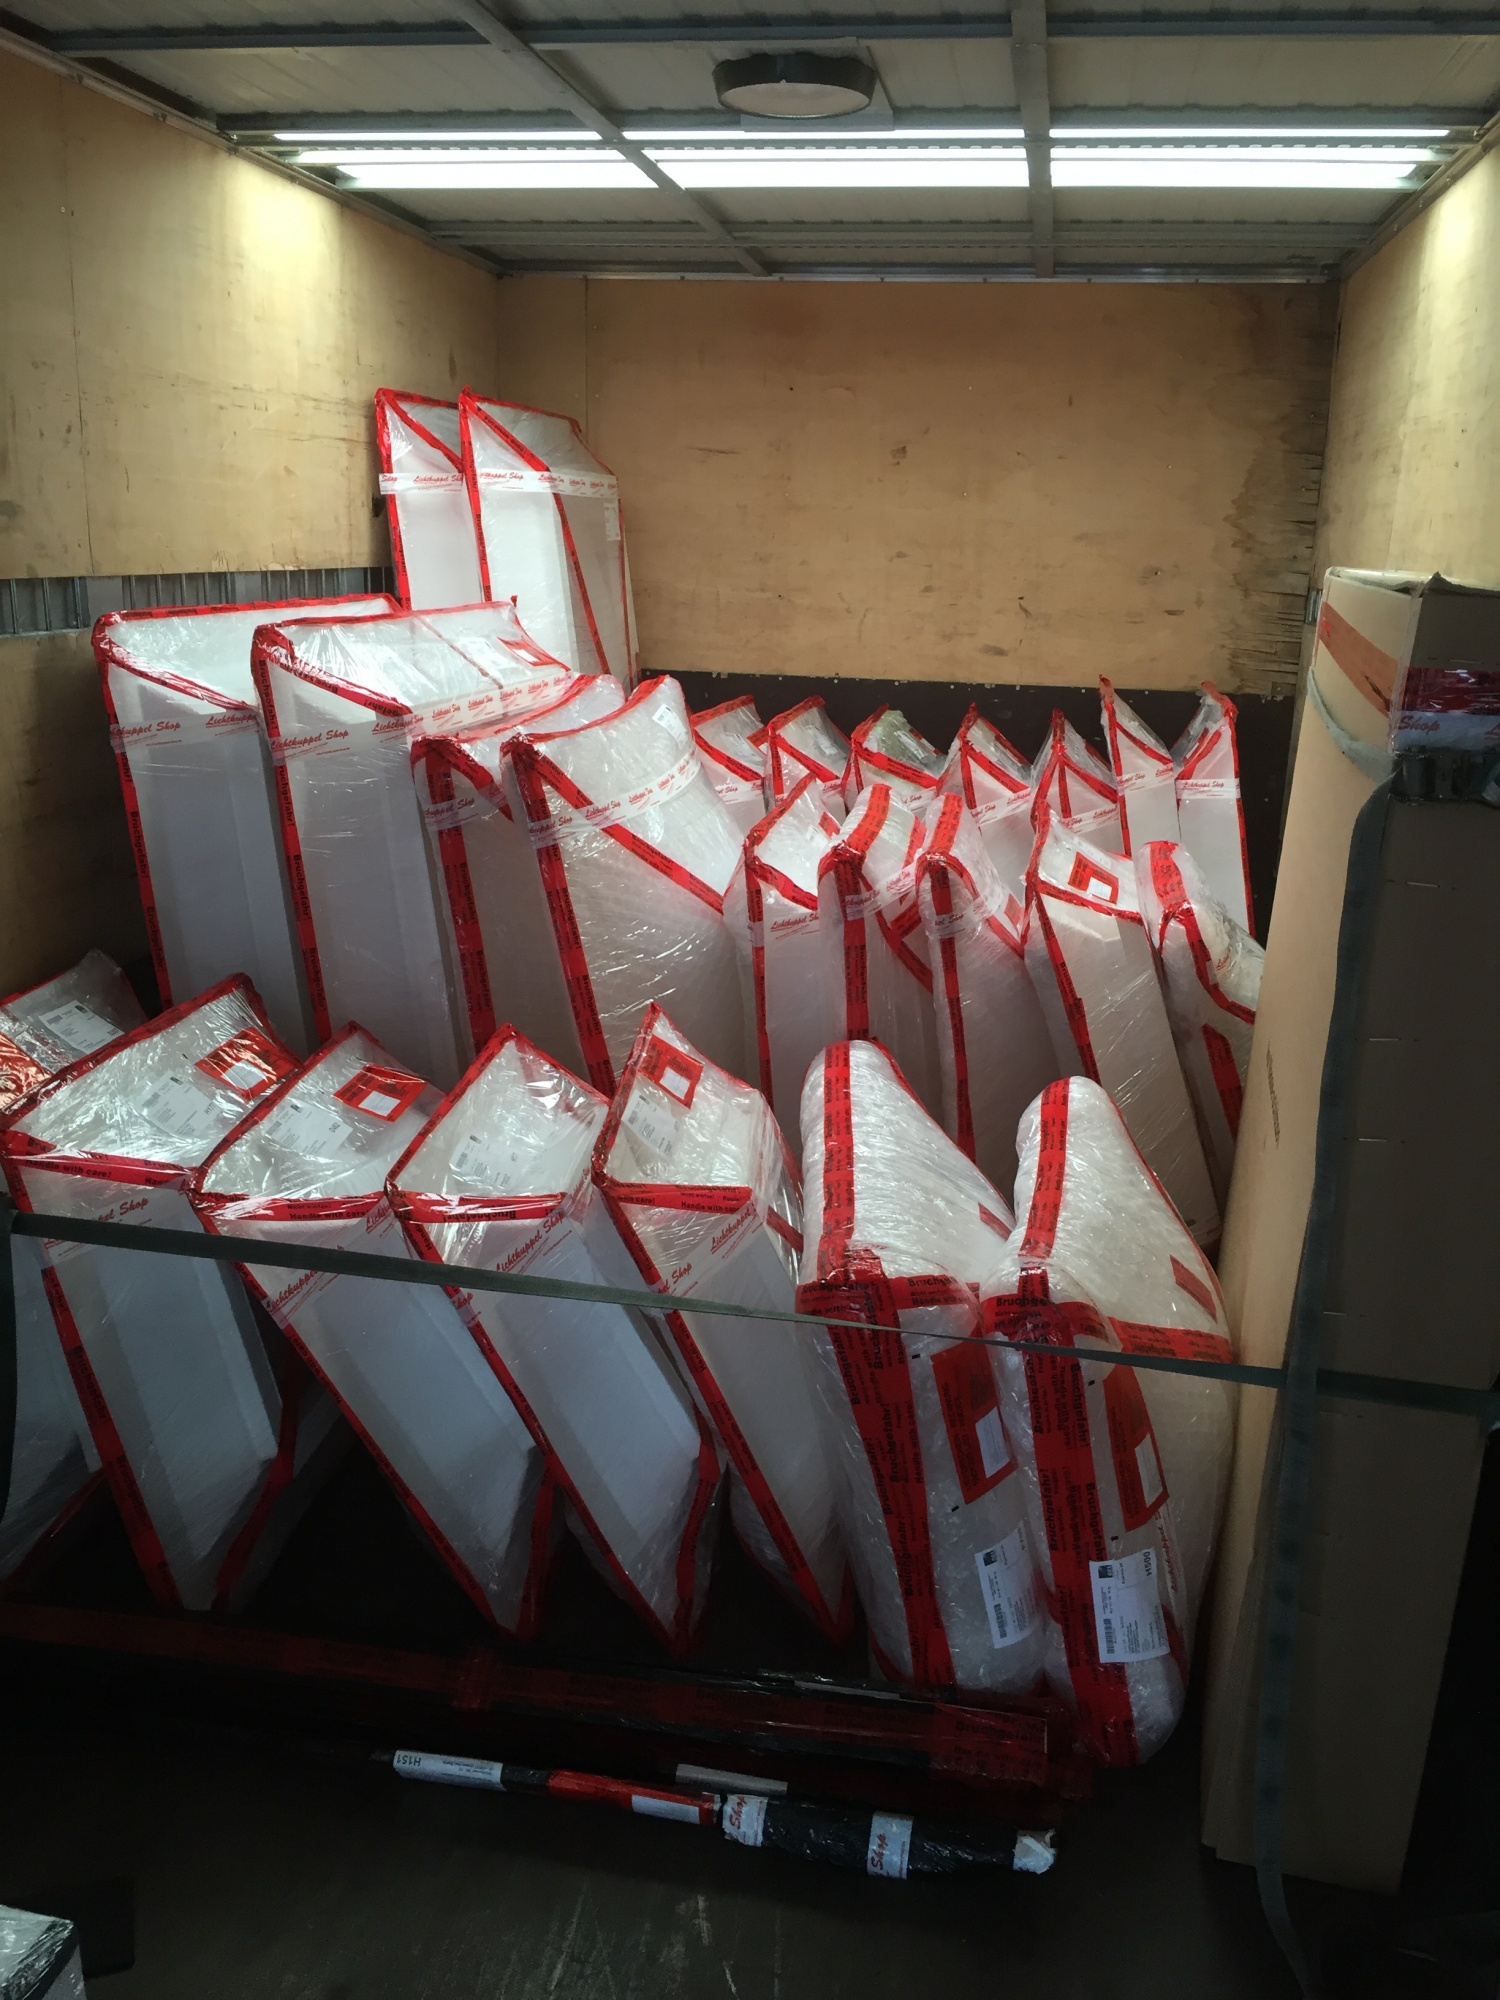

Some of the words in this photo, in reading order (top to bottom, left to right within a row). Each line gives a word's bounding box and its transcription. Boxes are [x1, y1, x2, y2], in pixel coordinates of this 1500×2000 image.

[259, 660, 279, 731] Bruchgefahr!
[156, 722, 181, 735] Shop
[326, 730, 351, 743] Shop
[1398, 715, 1441, 735] Shop
[279, 764, 295, 827] ruchgefahr!
[131, 811, 150, 879] Bruchgefahr!
[293, 854, 312, 921] Bruchgefahr!
[63, 1164, 83, 1175] with
[86, 1168, 111, 1178] care!
[119, 1197, 148, 1216] Shop
[672, 1200, 705, 1211] Handle
[707, 1205, 724, 1213] with
[496, 1229, 543, 1273] Lichtkuppel
[671, 1262, 692, 1285] Shop
[880, 1402, 900, 1484] Bruchgefahr!
[1143, 1551, 1153, 1576] H500
[397, 1754, 422, 1770] H151
[871, 1833, 886, 1870] Shop
